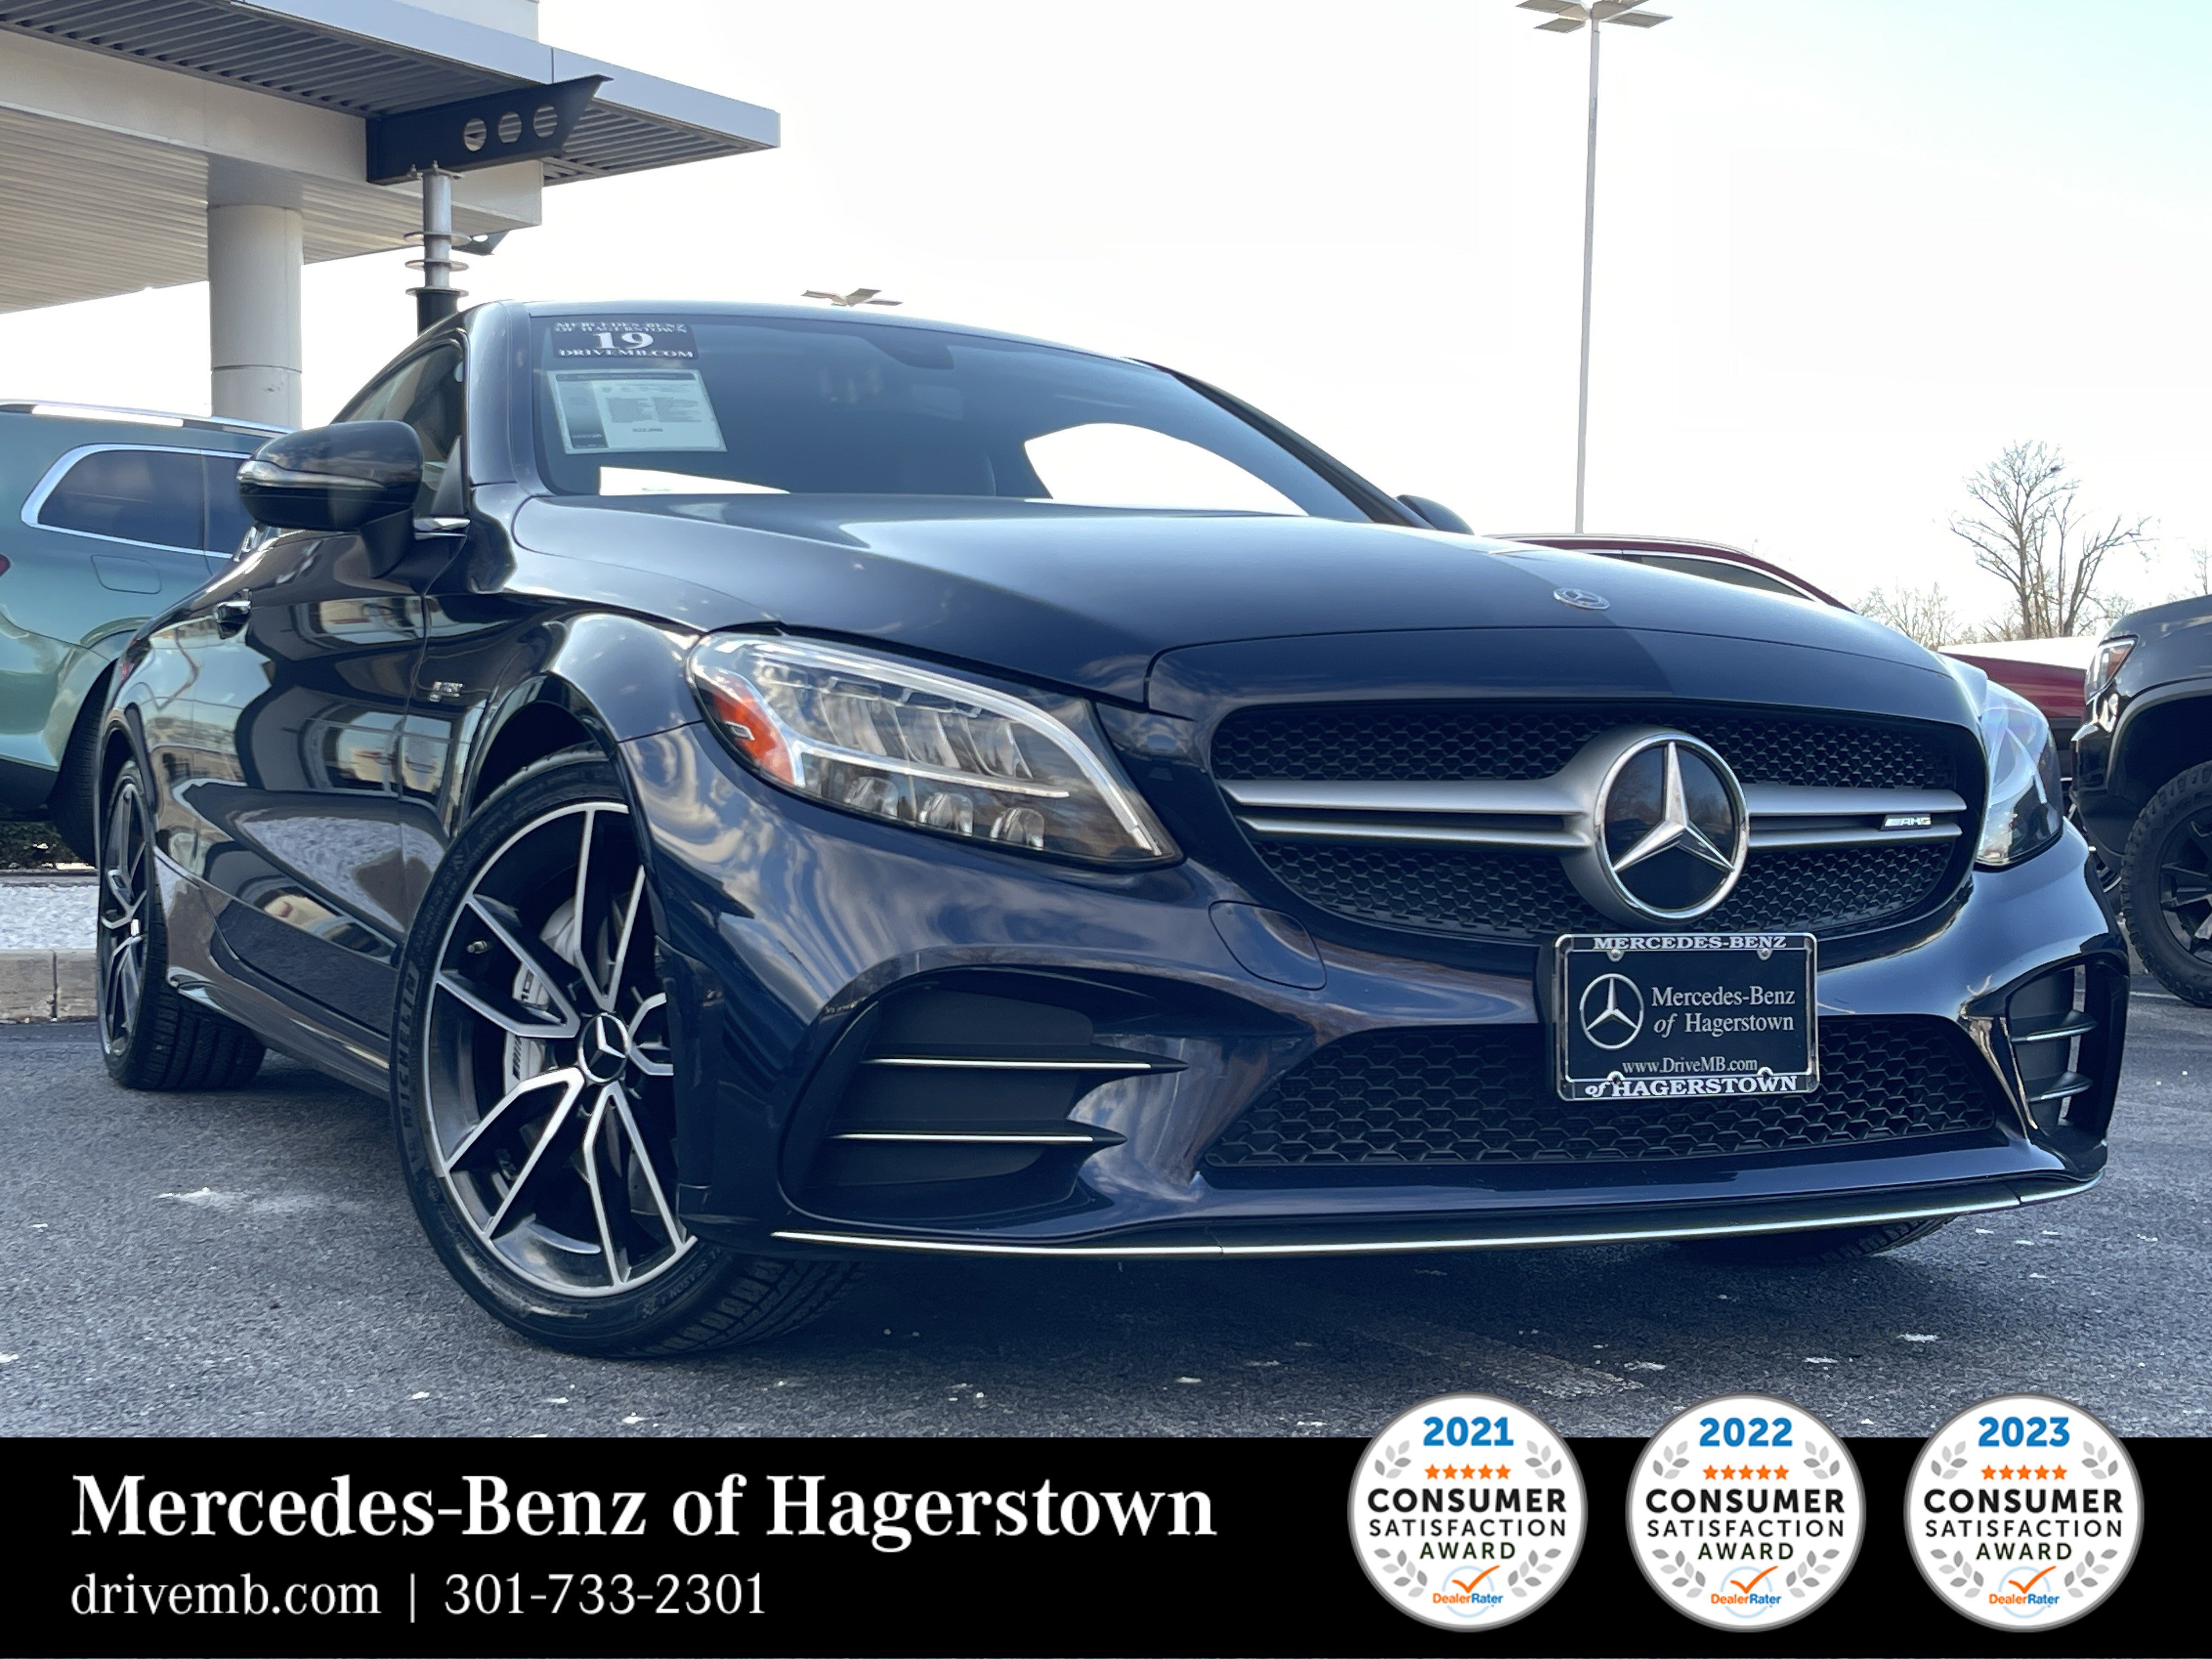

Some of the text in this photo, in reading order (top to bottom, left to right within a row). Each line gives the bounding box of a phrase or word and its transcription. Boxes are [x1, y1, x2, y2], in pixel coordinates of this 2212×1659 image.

[592, 331, 654, 349] 19
[1593, 936, 1786, 950] MERCEDES-BENZ
[1651, 985, 1796, 1007] Mercedes-Benz
[1654, 1012, 1795, 1038] of Hagerstown
[1622, 1056, 1758, 1074] www.DriveMB.com
[1585, 1075, 1798, 1098] of HAGERSTOWN
